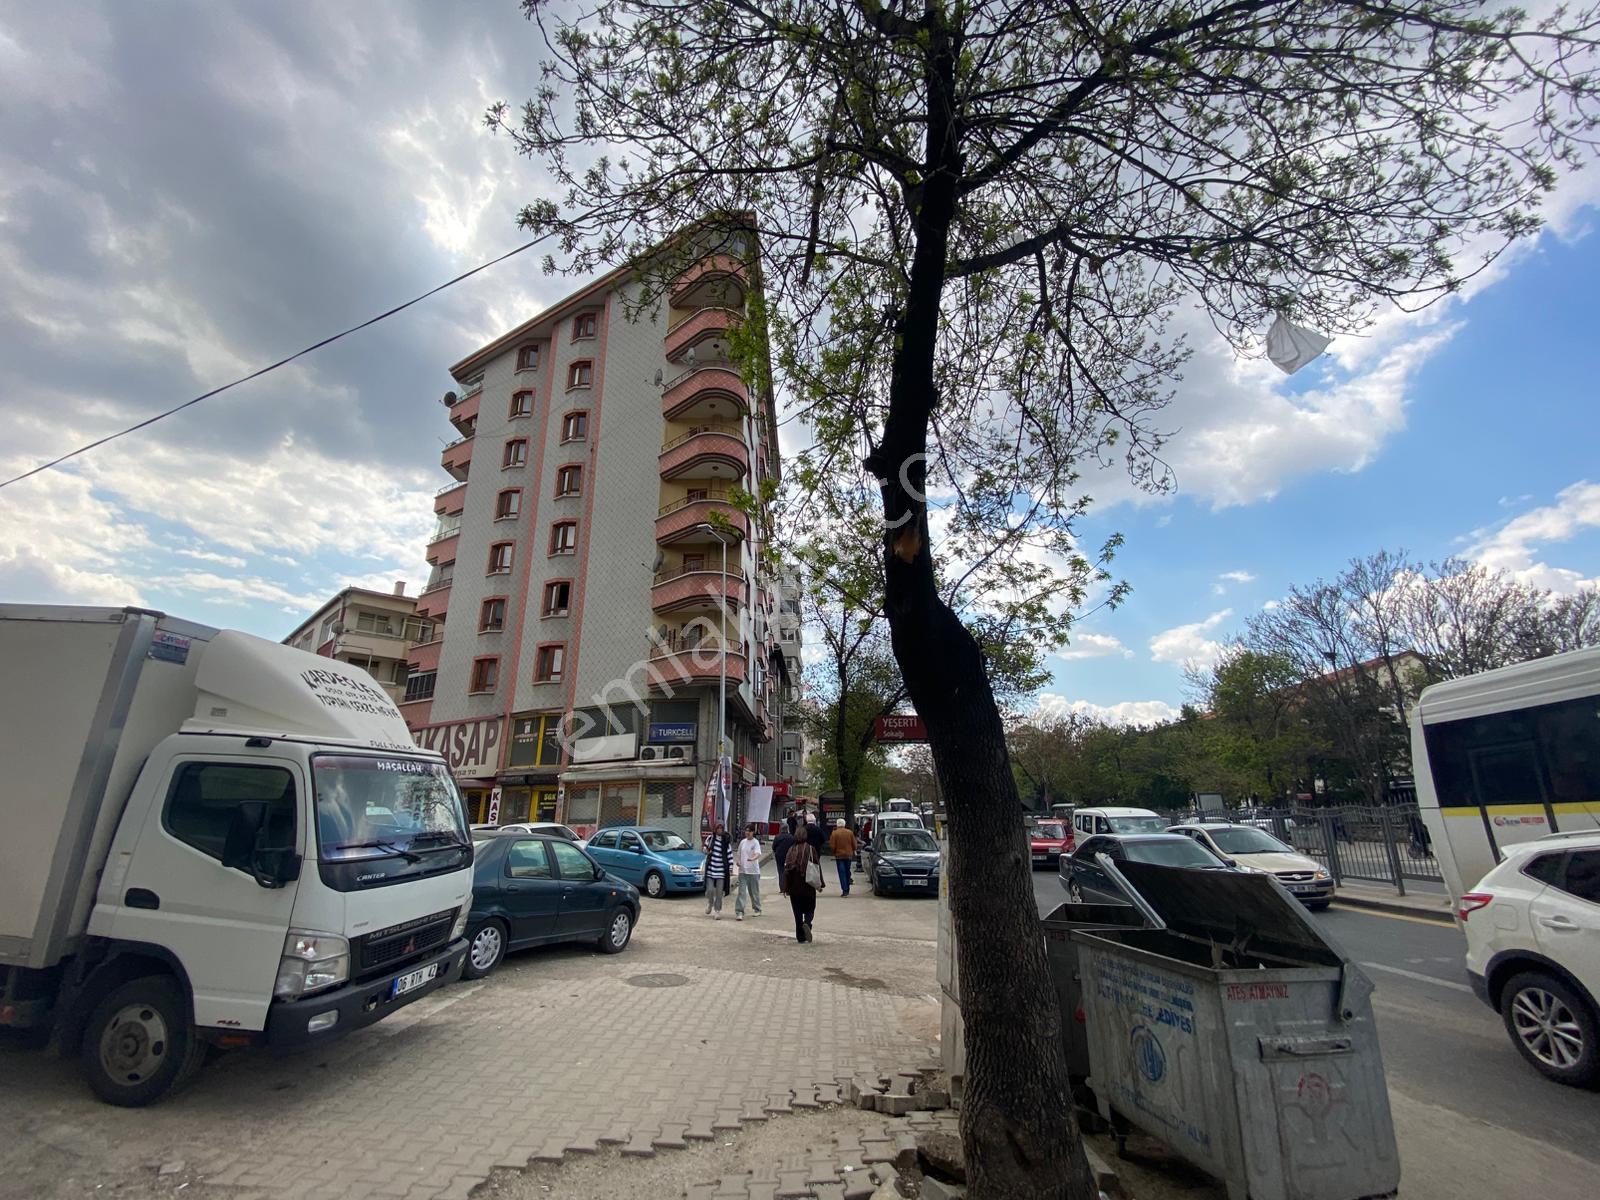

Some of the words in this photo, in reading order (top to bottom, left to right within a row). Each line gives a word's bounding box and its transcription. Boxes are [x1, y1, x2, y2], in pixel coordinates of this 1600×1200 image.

[658, 728, 694, 737] TURKCELL
[489, 791, 501, 824] KAS
[356, 873, 386, 882] CANTER
[397, 977, 408, 992] 06
[428, 964, 437, 978] 42
